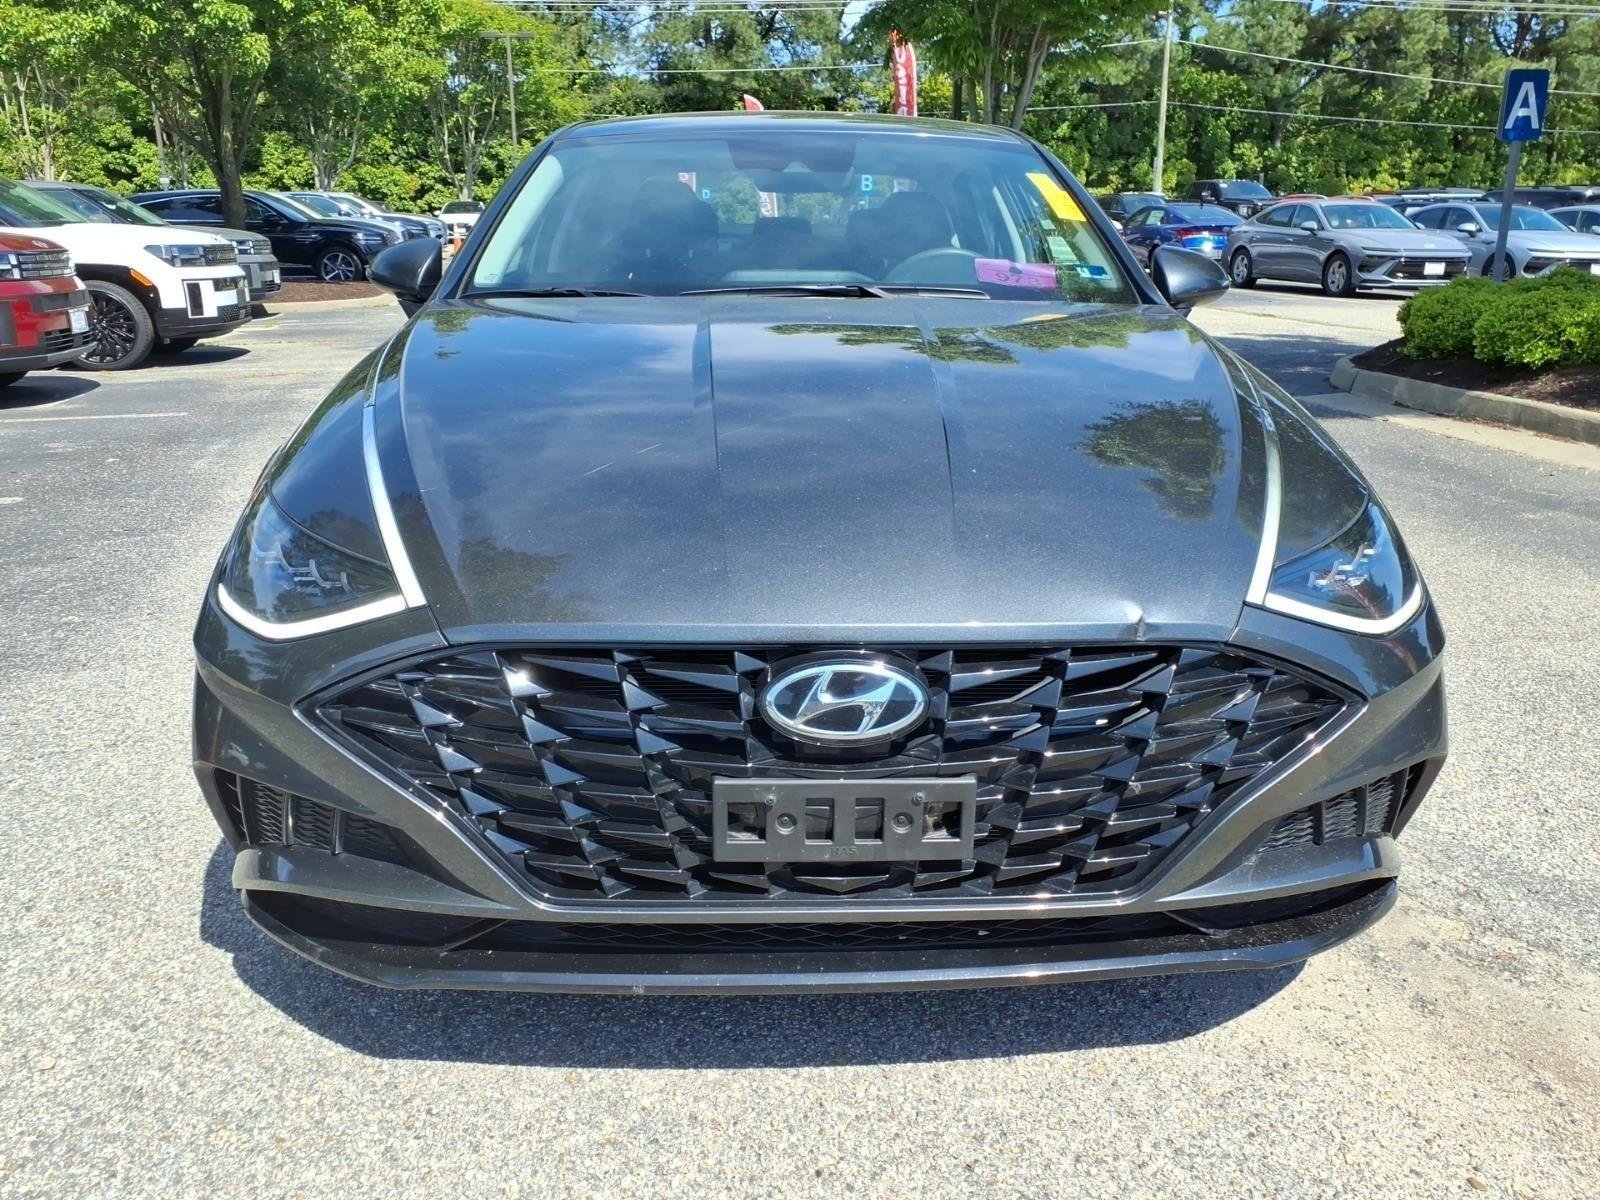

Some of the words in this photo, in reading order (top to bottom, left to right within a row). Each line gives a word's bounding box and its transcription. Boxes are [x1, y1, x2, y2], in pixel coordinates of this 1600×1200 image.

[1504, 81, 1540, 129] A
[861, 174, 873, 191] B
[702, 189, 711, 199] D
